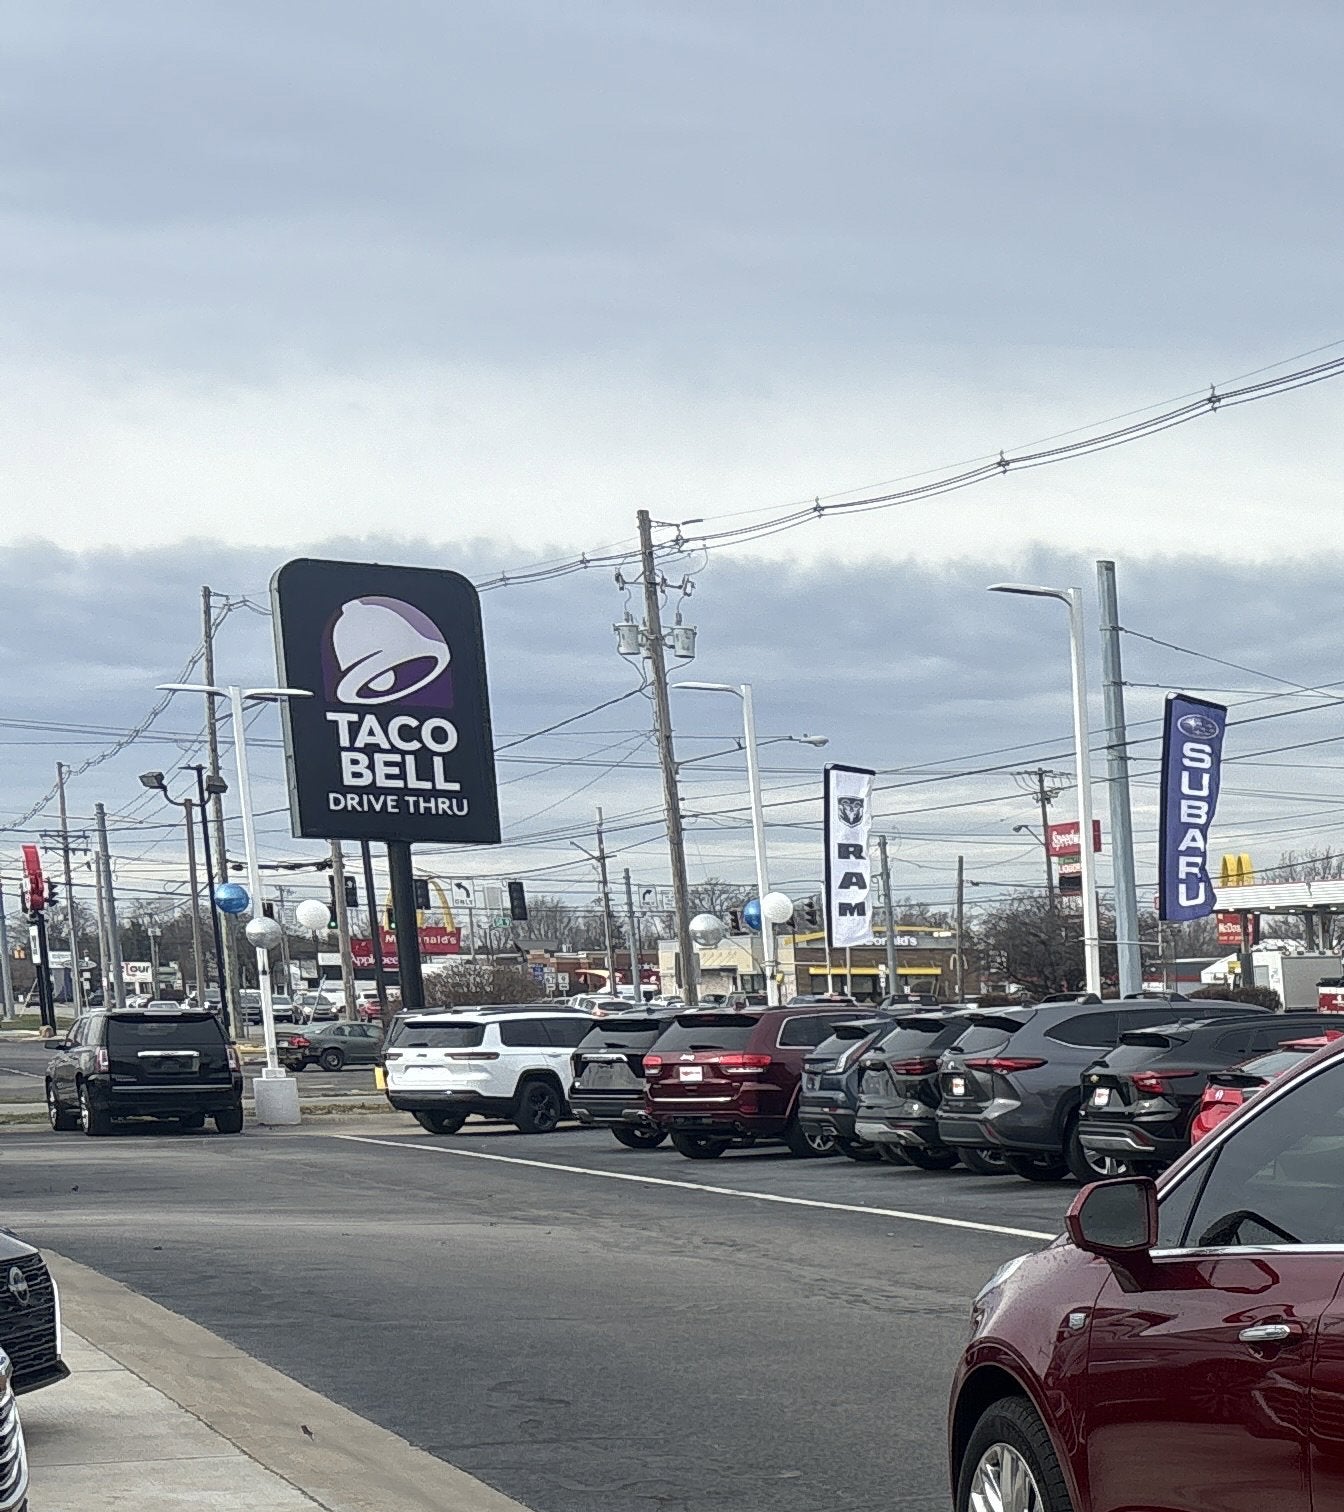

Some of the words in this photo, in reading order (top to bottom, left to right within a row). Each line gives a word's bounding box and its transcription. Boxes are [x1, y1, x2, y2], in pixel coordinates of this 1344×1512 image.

[326, 712, 458, 753] TACO
[341, 751, 461, 791] BELL
[328, 792, 400, 813] DRIVE
[404, 795, 469, 816] THRU
[1177, 741, 1213, 907] SUBARU
[1051, 829, 1080, 852] Speed
[837, 842, 868, 917] RAM
[385, 934, 457, 944] Mnald's
